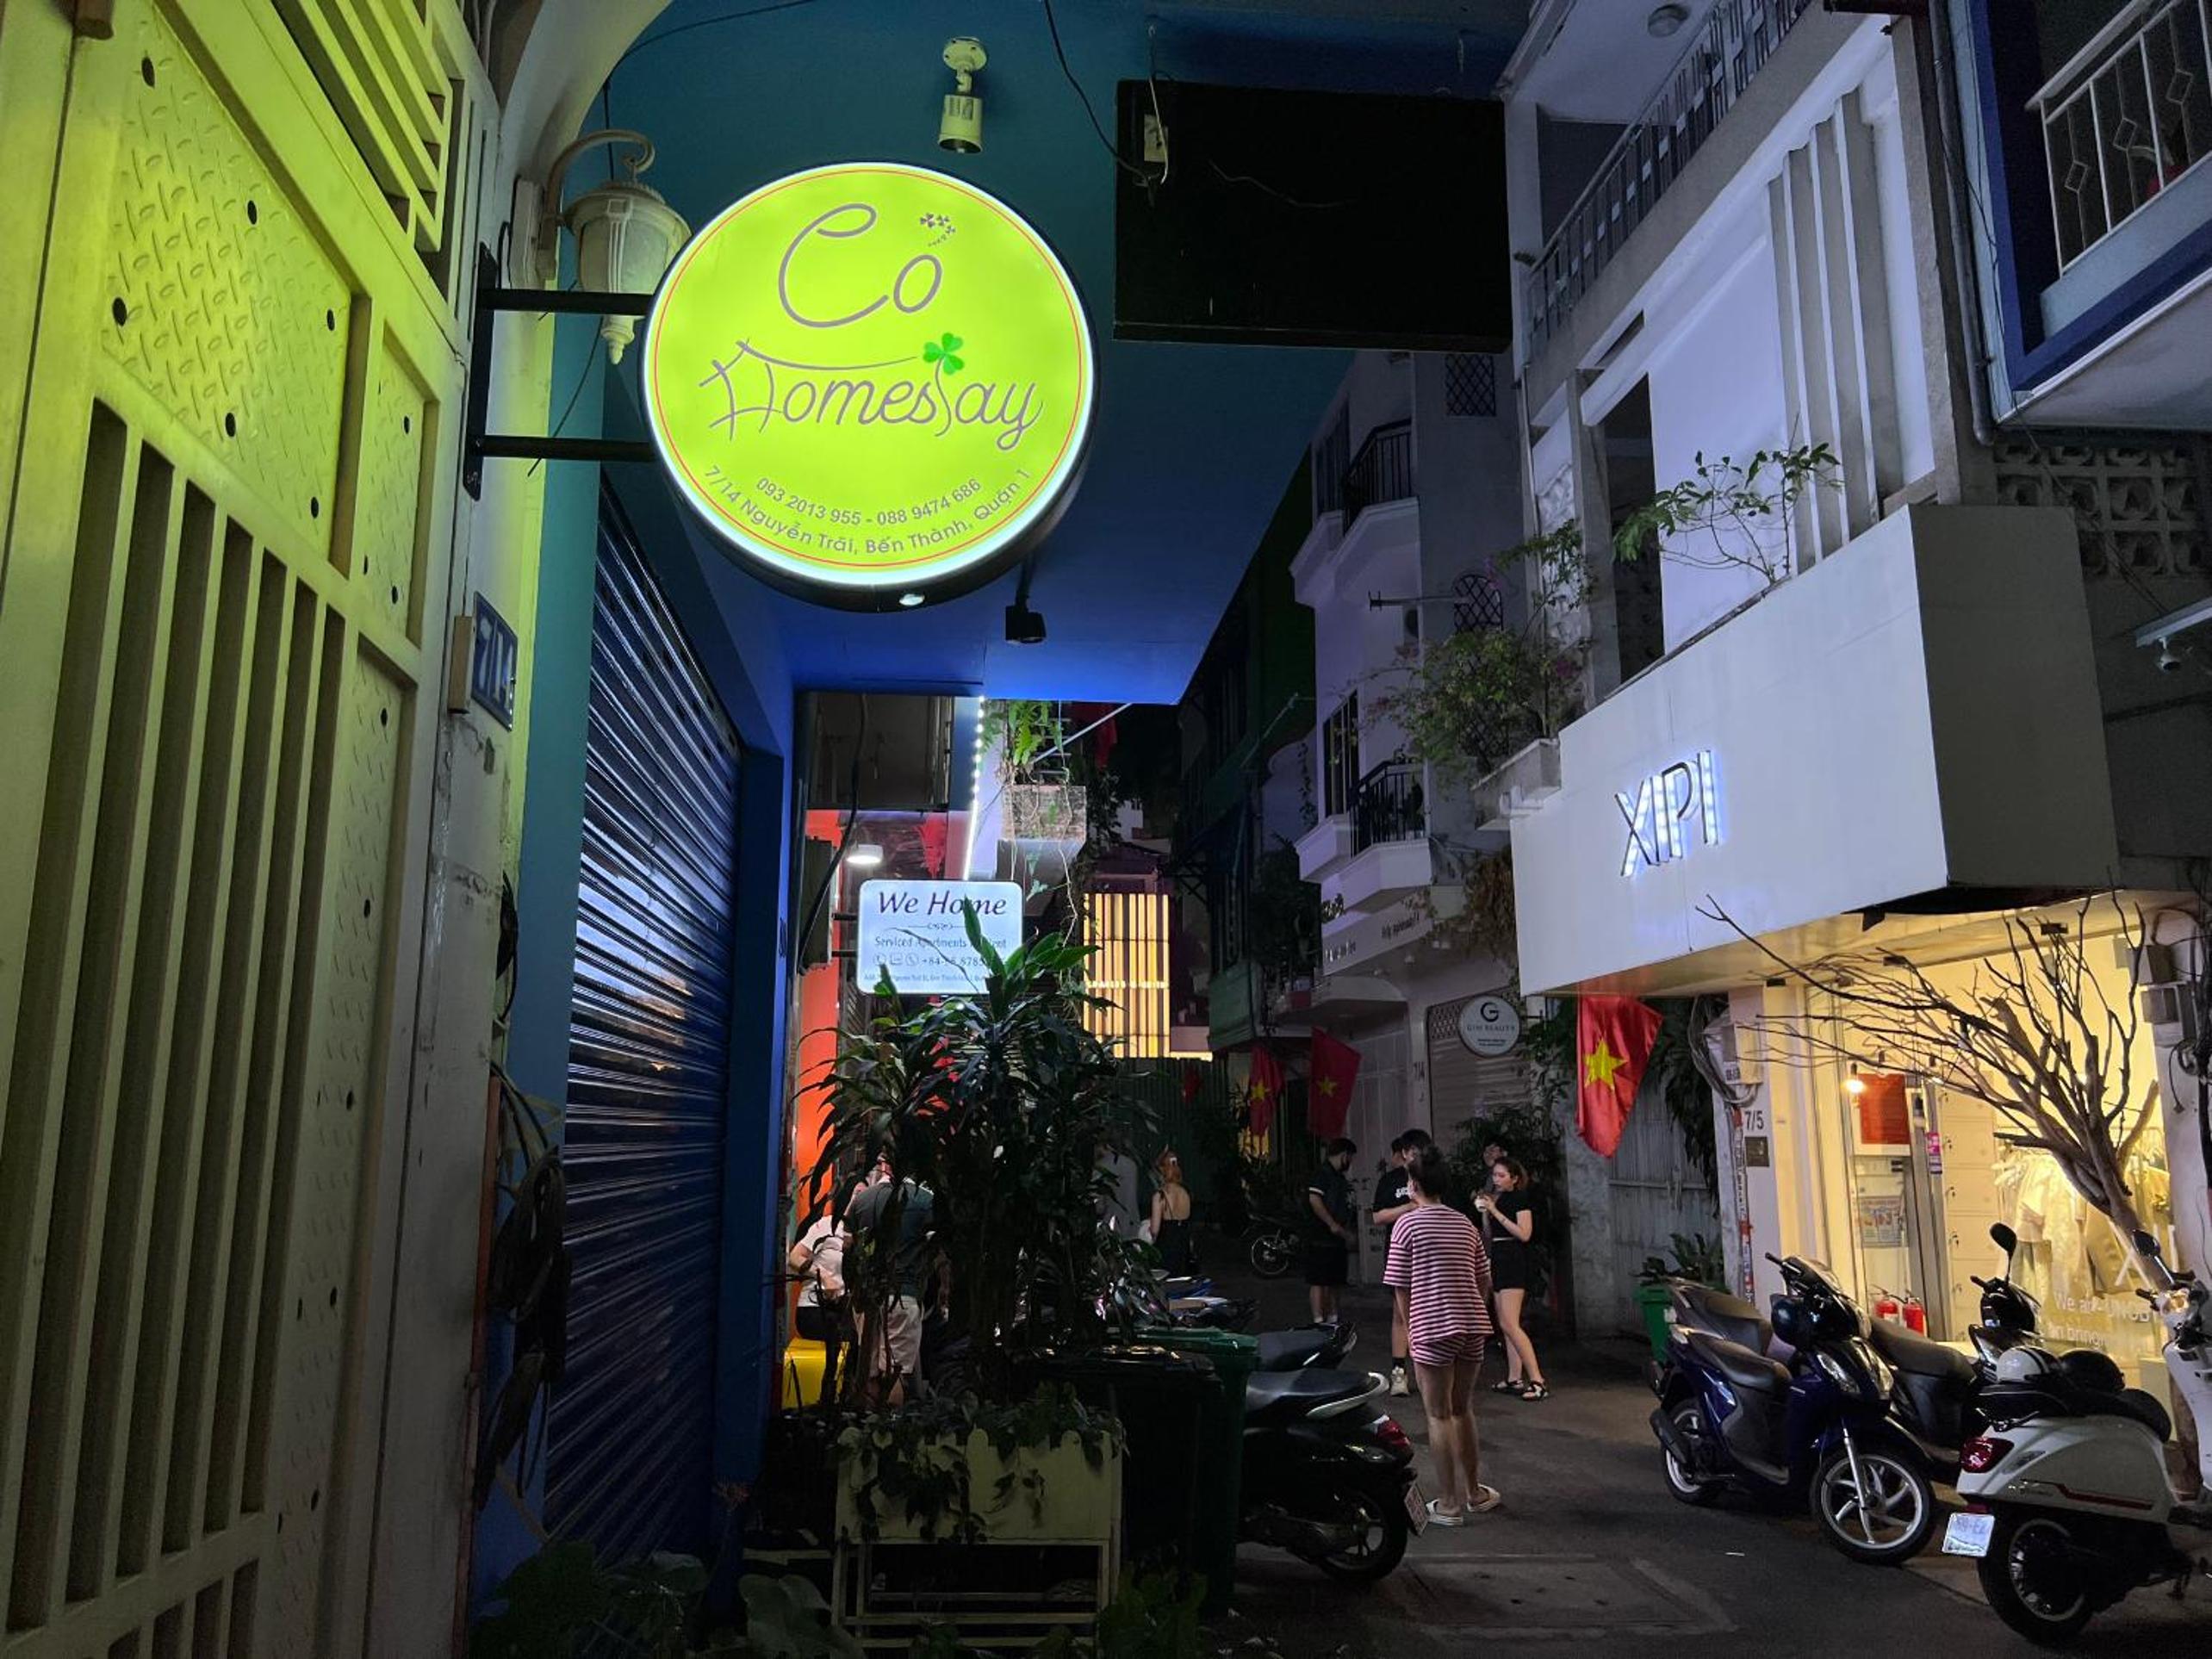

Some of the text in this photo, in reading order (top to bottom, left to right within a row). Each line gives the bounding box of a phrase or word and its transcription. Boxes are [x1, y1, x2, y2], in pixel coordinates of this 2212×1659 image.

[705, 464, 742, 503] 7/14
[867, 536, 904, 553] Bến
[756, 477, 786, 502] 093
[786, 495, 827, 519] 2013
[830, 509, 861, 525] 955
[877, 510, 907, 525] 088
[912, 496, 950, 519] 9474
[953, 478, 981, 502] 686
[1614, 750, 1718, 878] XPI
[879, 892, 918, 914] We
[1481, 1002, 1499, 1022] G
[1744, 1110, 1764, 1131] 7/5
